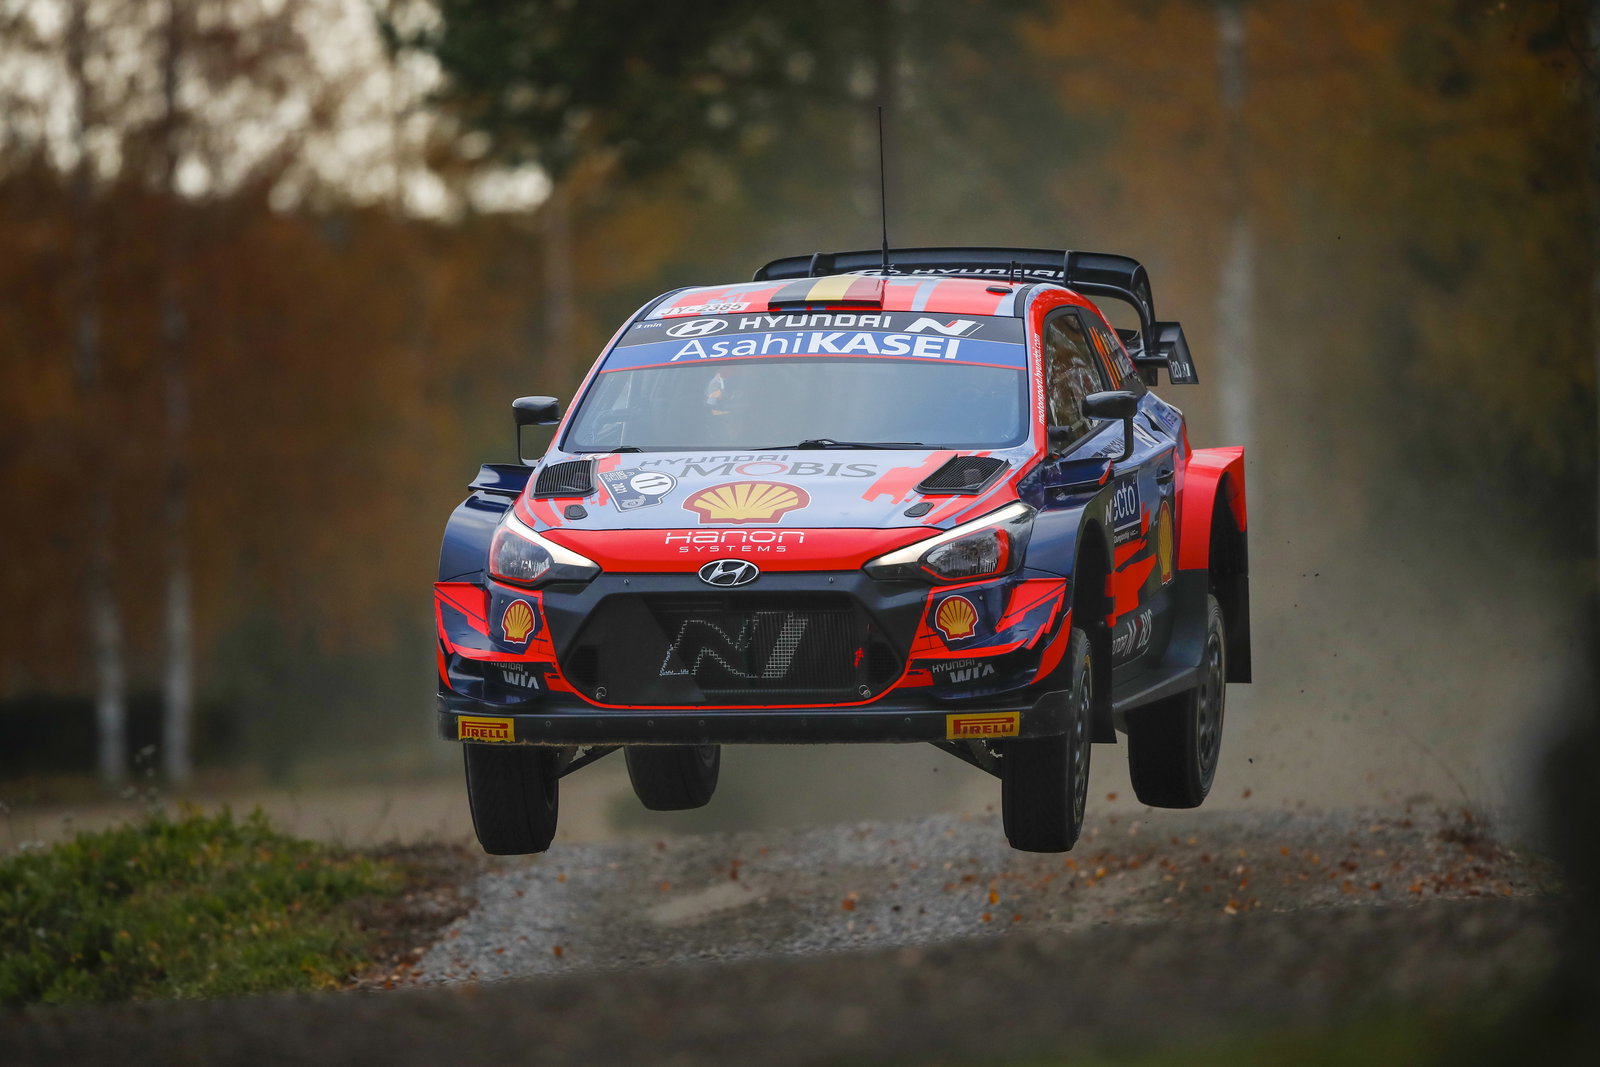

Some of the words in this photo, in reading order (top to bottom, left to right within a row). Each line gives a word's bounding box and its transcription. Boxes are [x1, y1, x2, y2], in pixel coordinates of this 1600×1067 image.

[661, 302, 742, 316] JY-2385
[738, 314, 892, 330] HYUNDAI
[639, 454, 789, 467] HYUNDAI
[678, 461, 878, 478] MOBIS
[679, 545, 787, 553] SYSTEMS
[932, 658, 975, 674] HYUNDAI
[461, 720, 509, 739] PIRELLI
[953, 716, 1015, 735] PIRELLI
